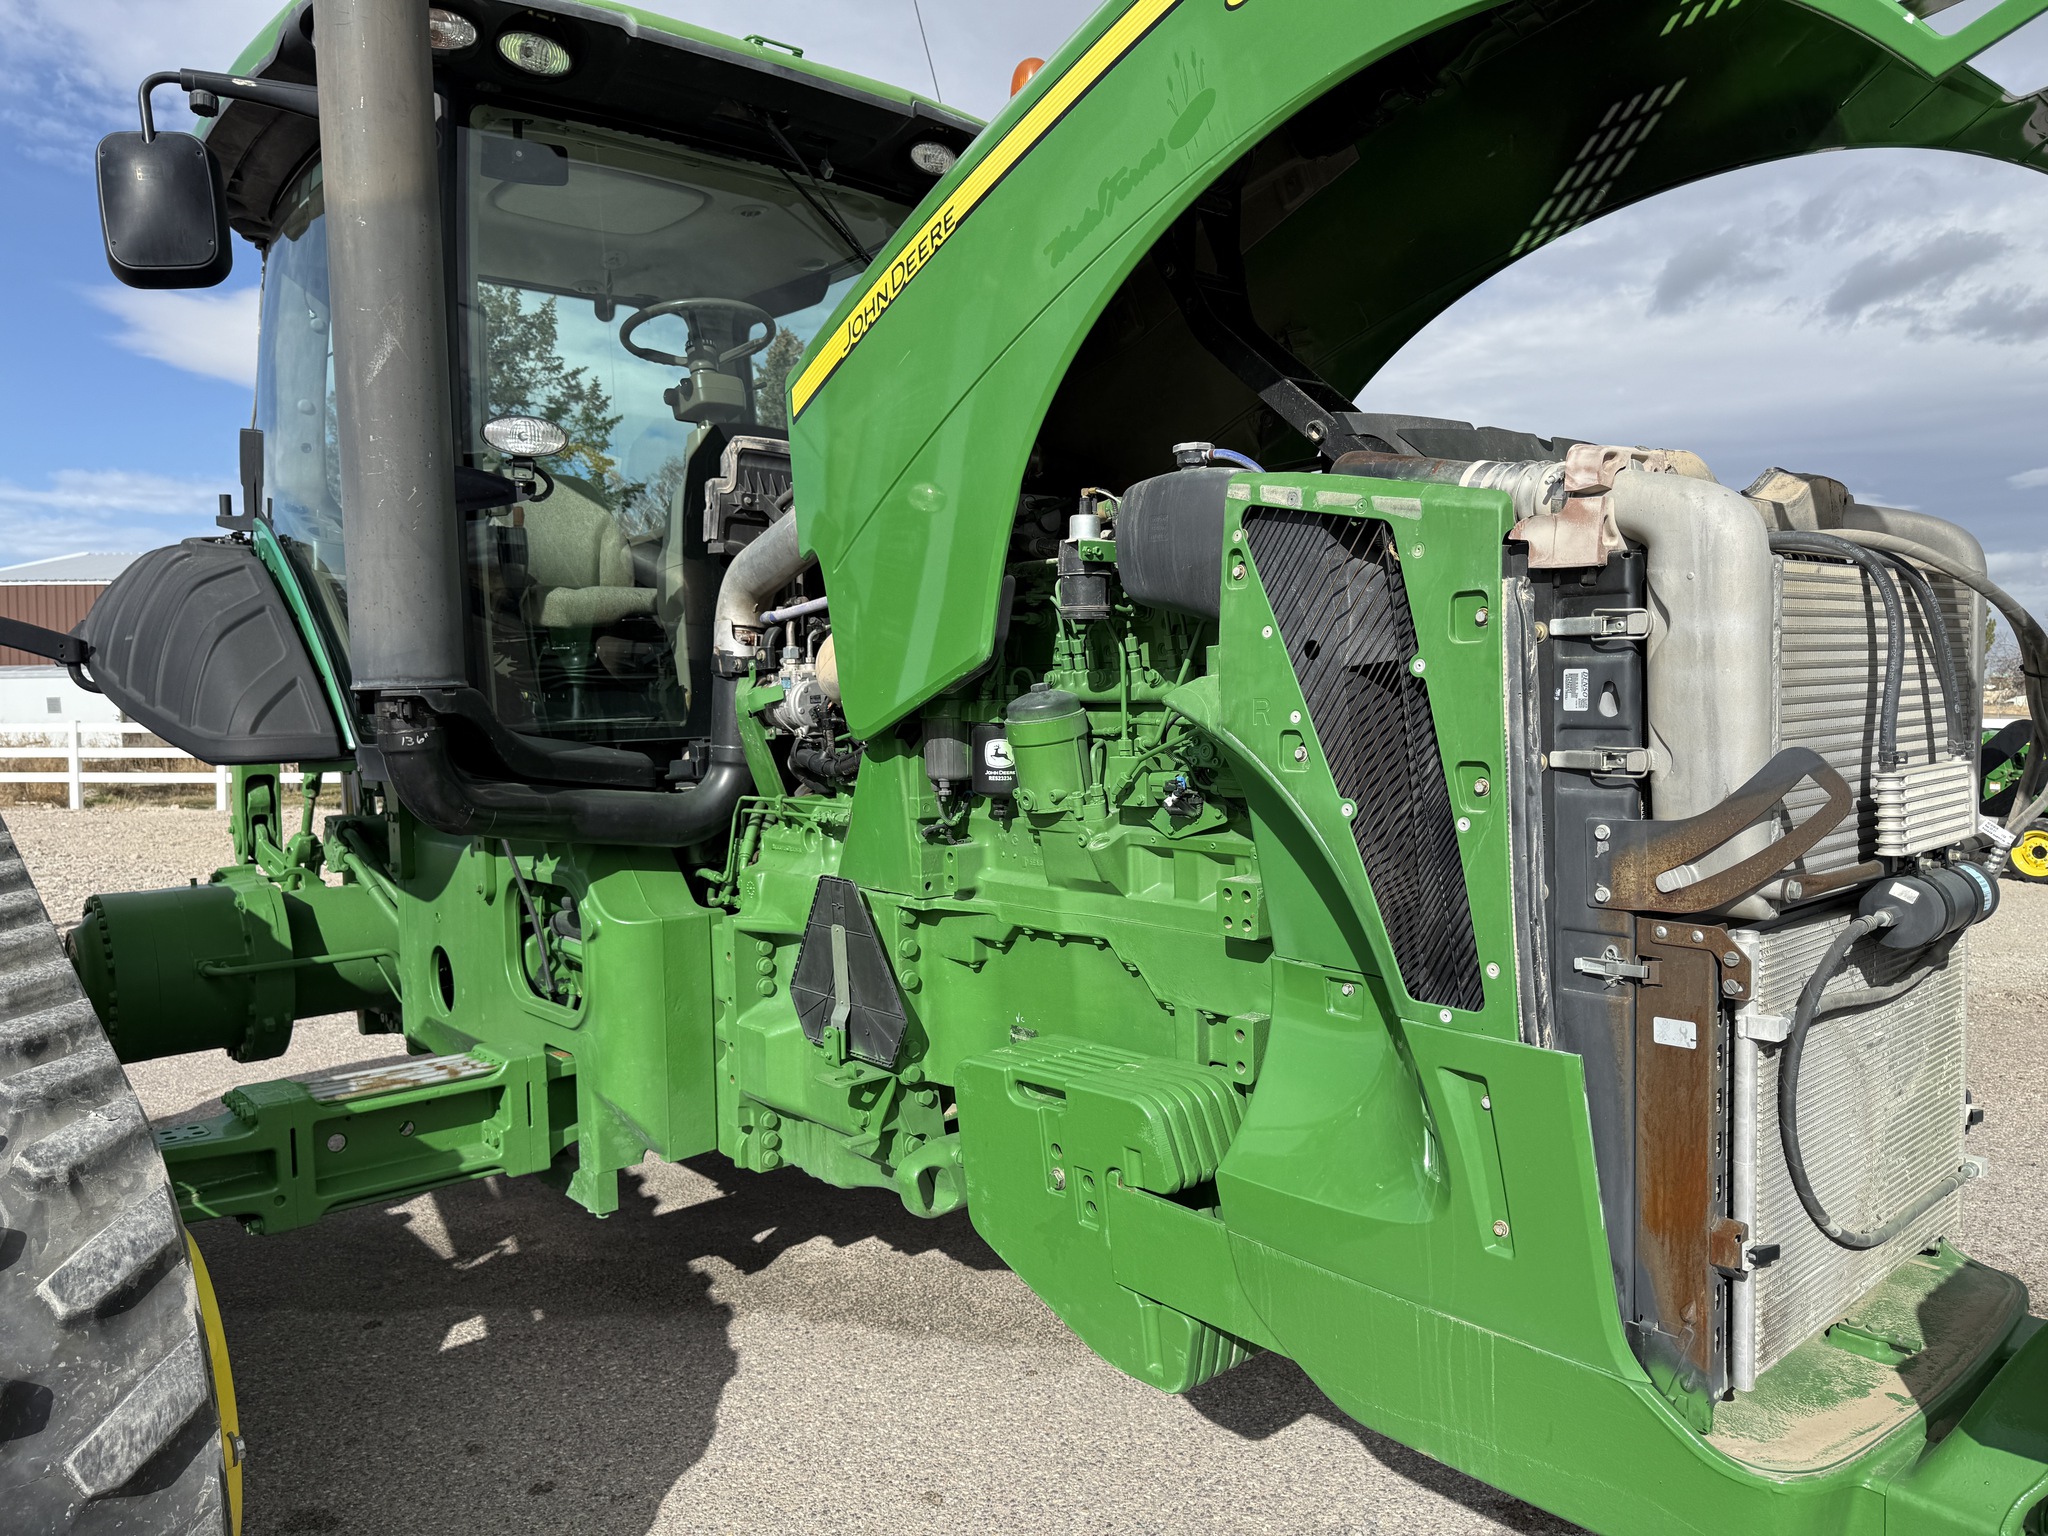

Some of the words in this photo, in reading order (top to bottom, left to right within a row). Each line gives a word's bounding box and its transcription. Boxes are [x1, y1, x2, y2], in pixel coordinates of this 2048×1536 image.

[843, 281, 889, 352] JOHN
[891, 205, 956, 294] DEERE
[1252, 697, 1271, 726] R
